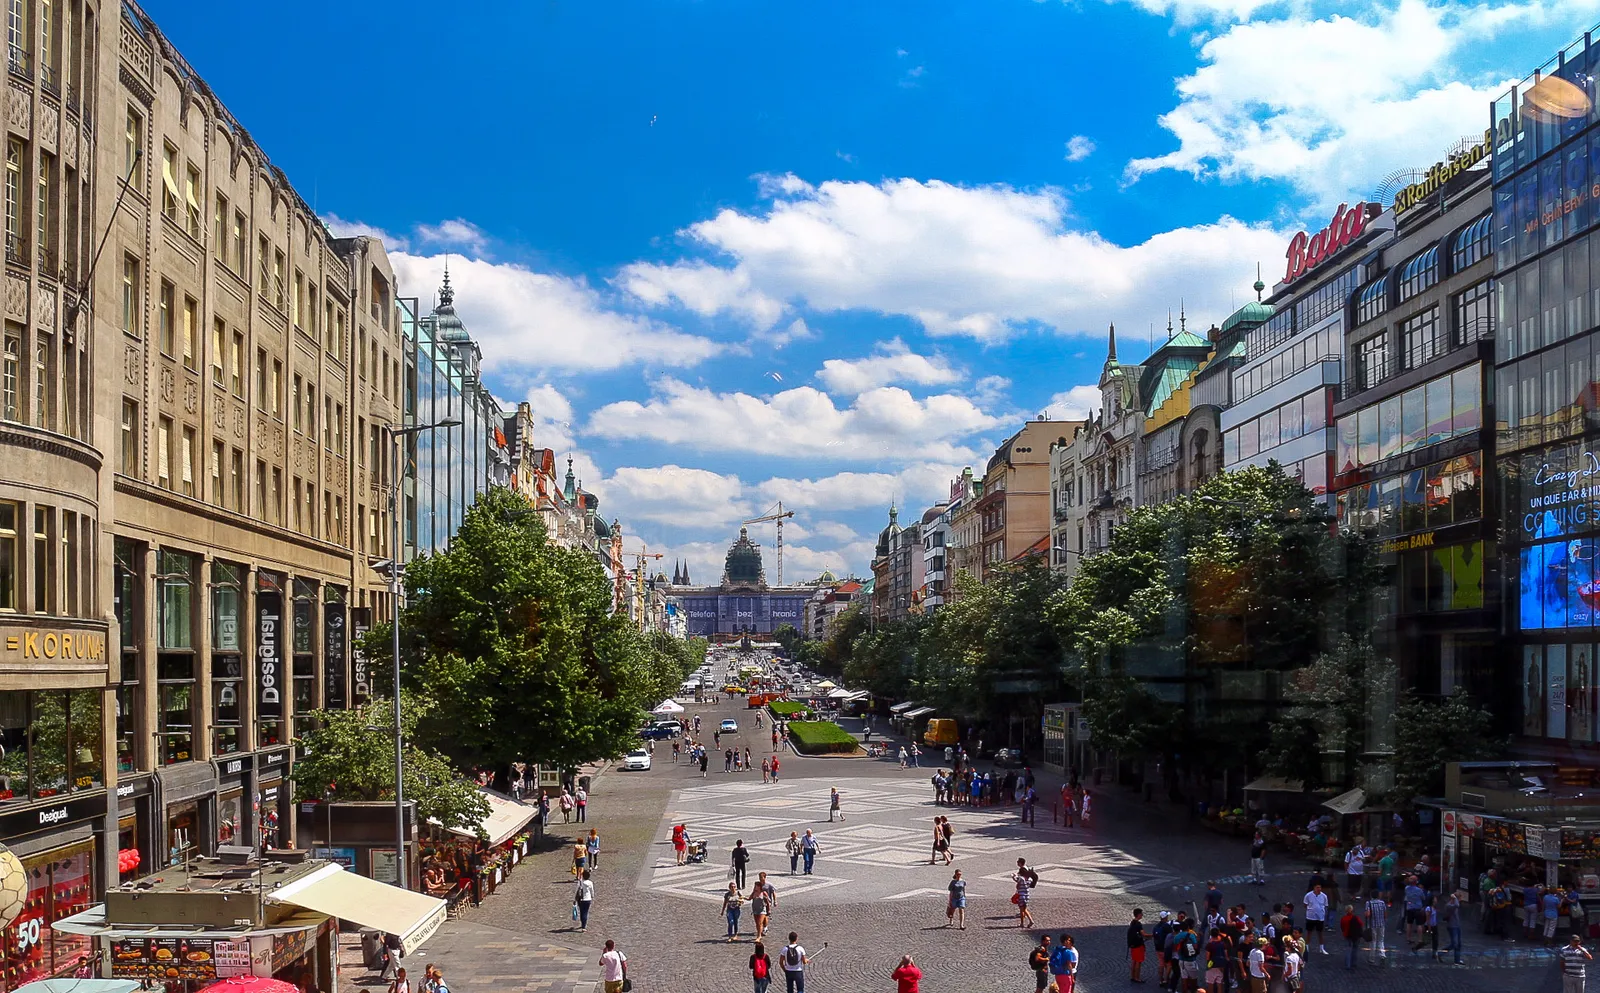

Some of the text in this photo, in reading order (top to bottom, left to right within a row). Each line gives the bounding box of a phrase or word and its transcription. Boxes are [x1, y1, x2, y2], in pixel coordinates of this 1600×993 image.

[1406, 143, 1480, 208] Raiffeisen
[1535, 463, 1581, 487] Crazy
[1410, 532, 1435, 549] BANK
[689, 610, 797, 619] Telefon bez hranic
[24, 631, 101, 660] KORUNA
[258, 614, 279, 703] Desigual
[40, 806, 67, 824] Desigual
